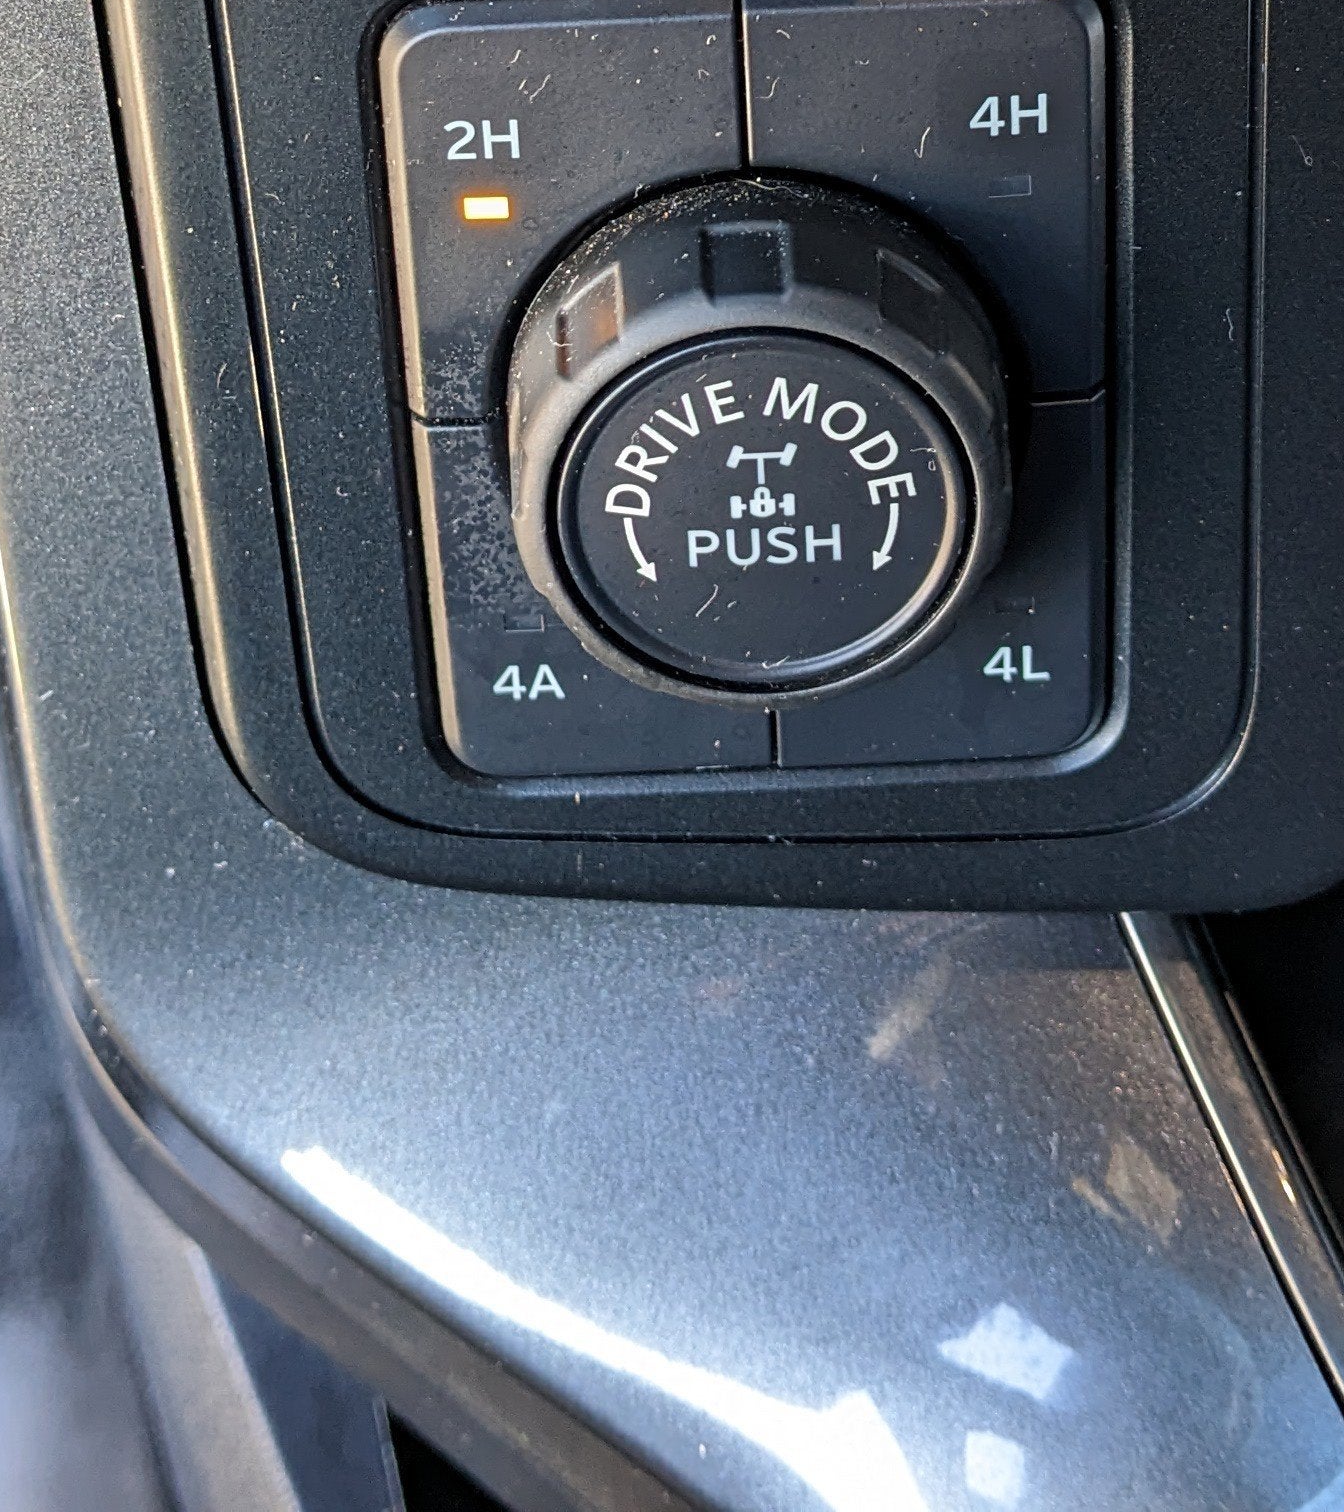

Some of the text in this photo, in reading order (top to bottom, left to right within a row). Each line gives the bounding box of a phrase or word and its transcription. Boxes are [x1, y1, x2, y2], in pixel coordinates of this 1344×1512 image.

[969, 93, 1049, 137] 4H
[443, 119, 521, 160] 2H
[605, 377, 918, 518] DRIVE MODE
[687, 523, 843, 568] PUSH
[492, 664, 566, 701] 4A
[983, 645, 1051, 683] 4L
